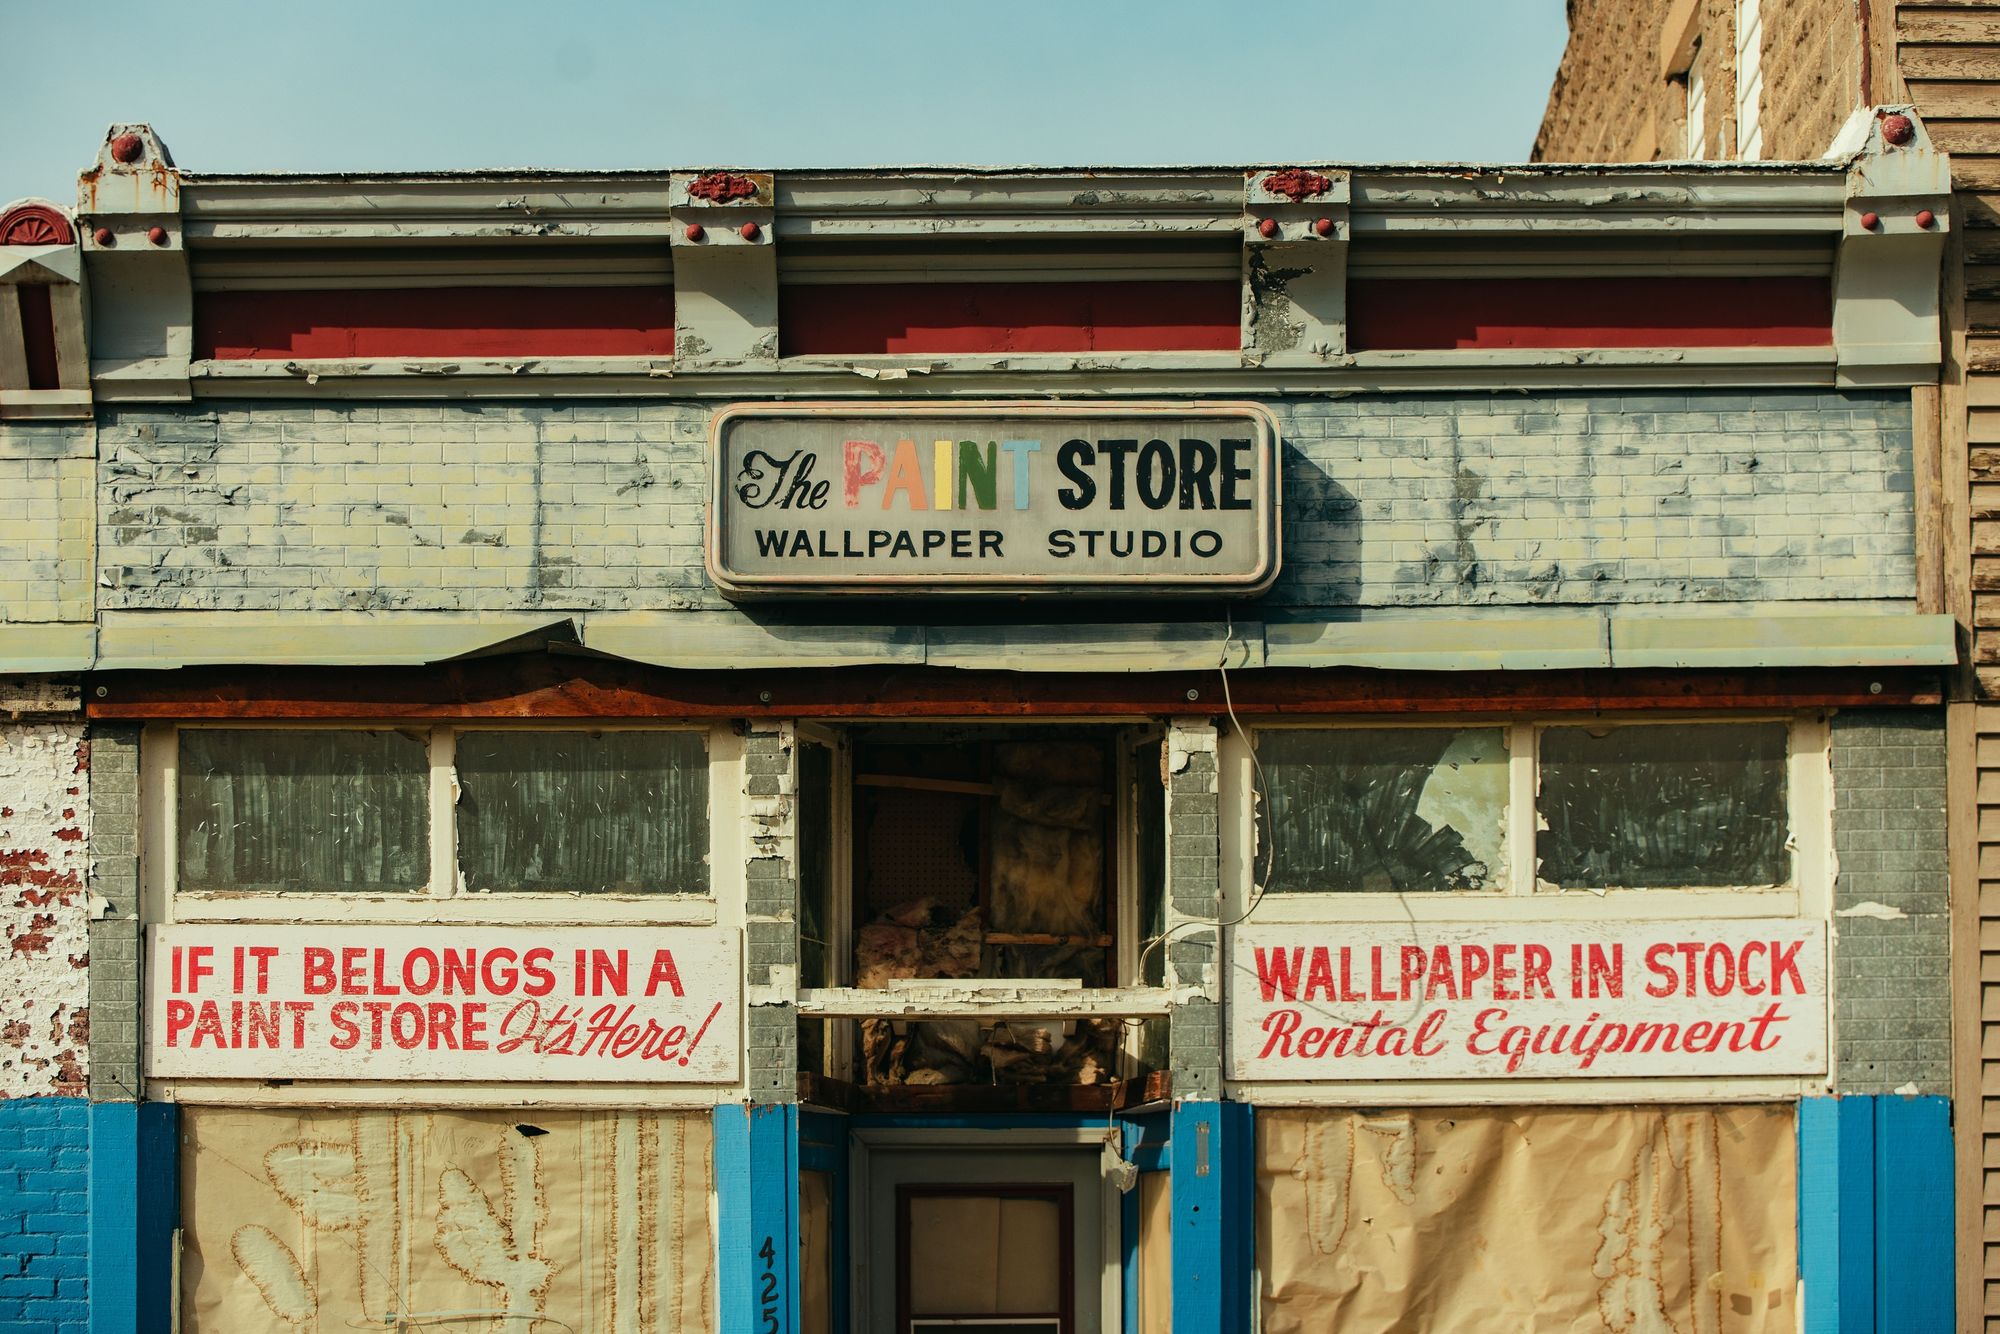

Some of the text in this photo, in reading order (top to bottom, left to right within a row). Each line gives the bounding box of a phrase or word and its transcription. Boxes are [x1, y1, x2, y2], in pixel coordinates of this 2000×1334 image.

[734, 438, 1252, 511] The PAINT STORE
[754, 529, 1223, 558] WALLPAPER STUDIO
[171, 945, 685, 997] IF IT BELONGS IN A
[1253, 940, 1807, 1002] WALLPAPER IN STOCK
[166, 999, 723, 1067] PAINT STORE It's Here!
[1257, 1002, 1790, 1073] Rental Equipment
[758, 1236, 780, 1334] 425
